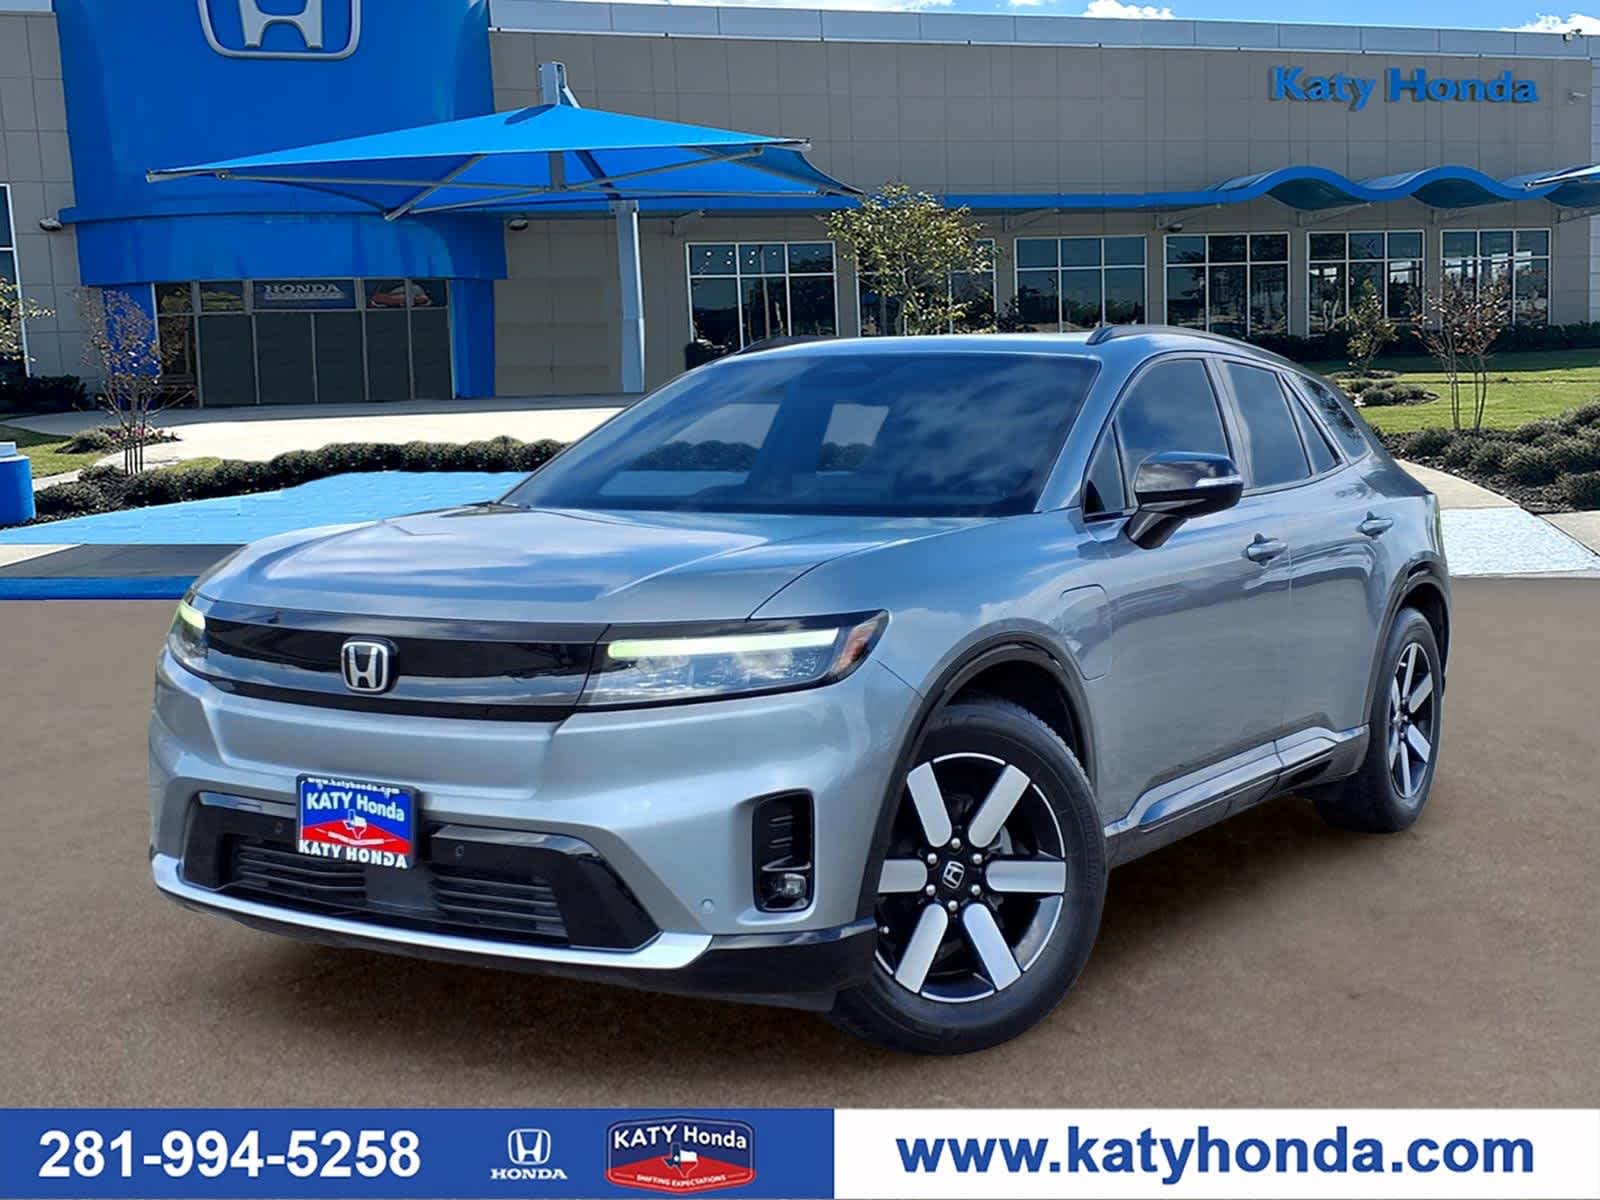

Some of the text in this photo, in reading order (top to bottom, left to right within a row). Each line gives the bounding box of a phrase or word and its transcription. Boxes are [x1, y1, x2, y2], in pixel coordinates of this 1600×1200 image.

[1270, 66, 1539, 111] Katy Honda
[264, 284, 343, 299] HONDA
[306, 791, 405, 822] KATY Honda
[298, 839, 408, 869] KATY HONDA
